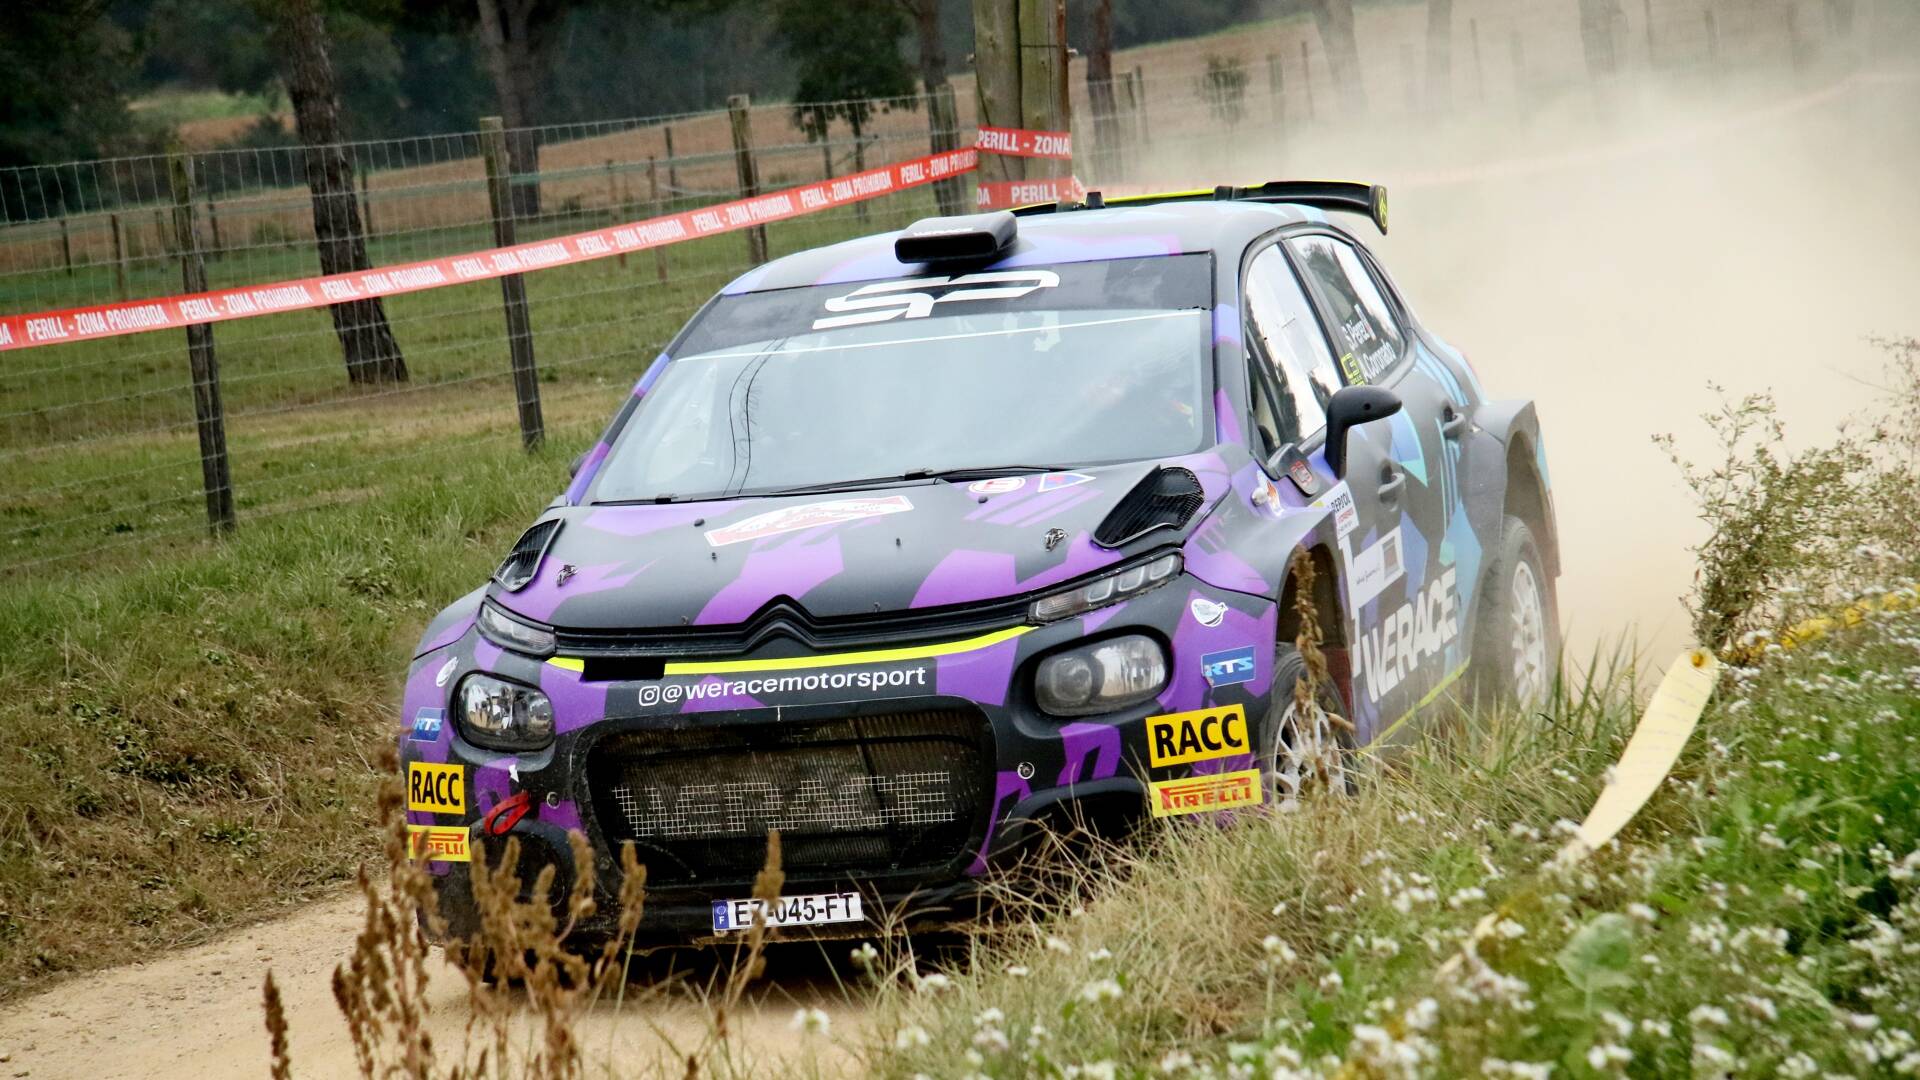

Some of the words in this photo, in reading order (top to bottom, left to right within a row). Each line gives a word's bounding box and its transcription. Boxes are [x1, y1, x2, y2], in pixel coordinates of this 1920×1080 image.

[979, 130, 1019, 152] PERILL
[1033, 135, 1070, 155] ZONA
[1010, 183, 1061, 204] PERILL
[26, 318, 68, 341] PERILL
[74, 313, 107, 335] ZONA
[106, 305, 169, 331] PROHIBIDA
[178, 298, 219, 321] PERILL
[224, 293, 257, 314] ZONA
[253, 286, 313, 311] PROHIBIDA
[320, 279, 361, 299] PERILL
[361, 273, 393, 293] ZONA
[390, 265, 447, 289] PROHIBIDA
[452, 257, 491, 279] PERILL
[491, 251, 522, 272] ZONA
[517, 242, 571, 267] PROHIBIDA
[576, 234, 611, 255] PERILL
[613, 228, 641, 249] ZONA
[691, 211, 725, 232] PERILL
[726, 205, 752, 226] ZONA
[799, 186, 829, 208] PERILL
[831, 180, 855, 201] ZONA
[851, 170, 893, 195] PROHIBIDA
[900, 163, 925, 184] PERILL
[929, 156, 949, 177] ZONA
[1331, 493, 1351, 513] REPSOL
[1205, 655, 1254, 677] RTS
[662, 665, 926, 703] @weracemotorsport
[1154, 712, 1243, 759] RACC
[411, 770, 460, 806] RACC
[1159, 777, 1251, 810] PIRELLI
[719, 916, 725, 925] F
